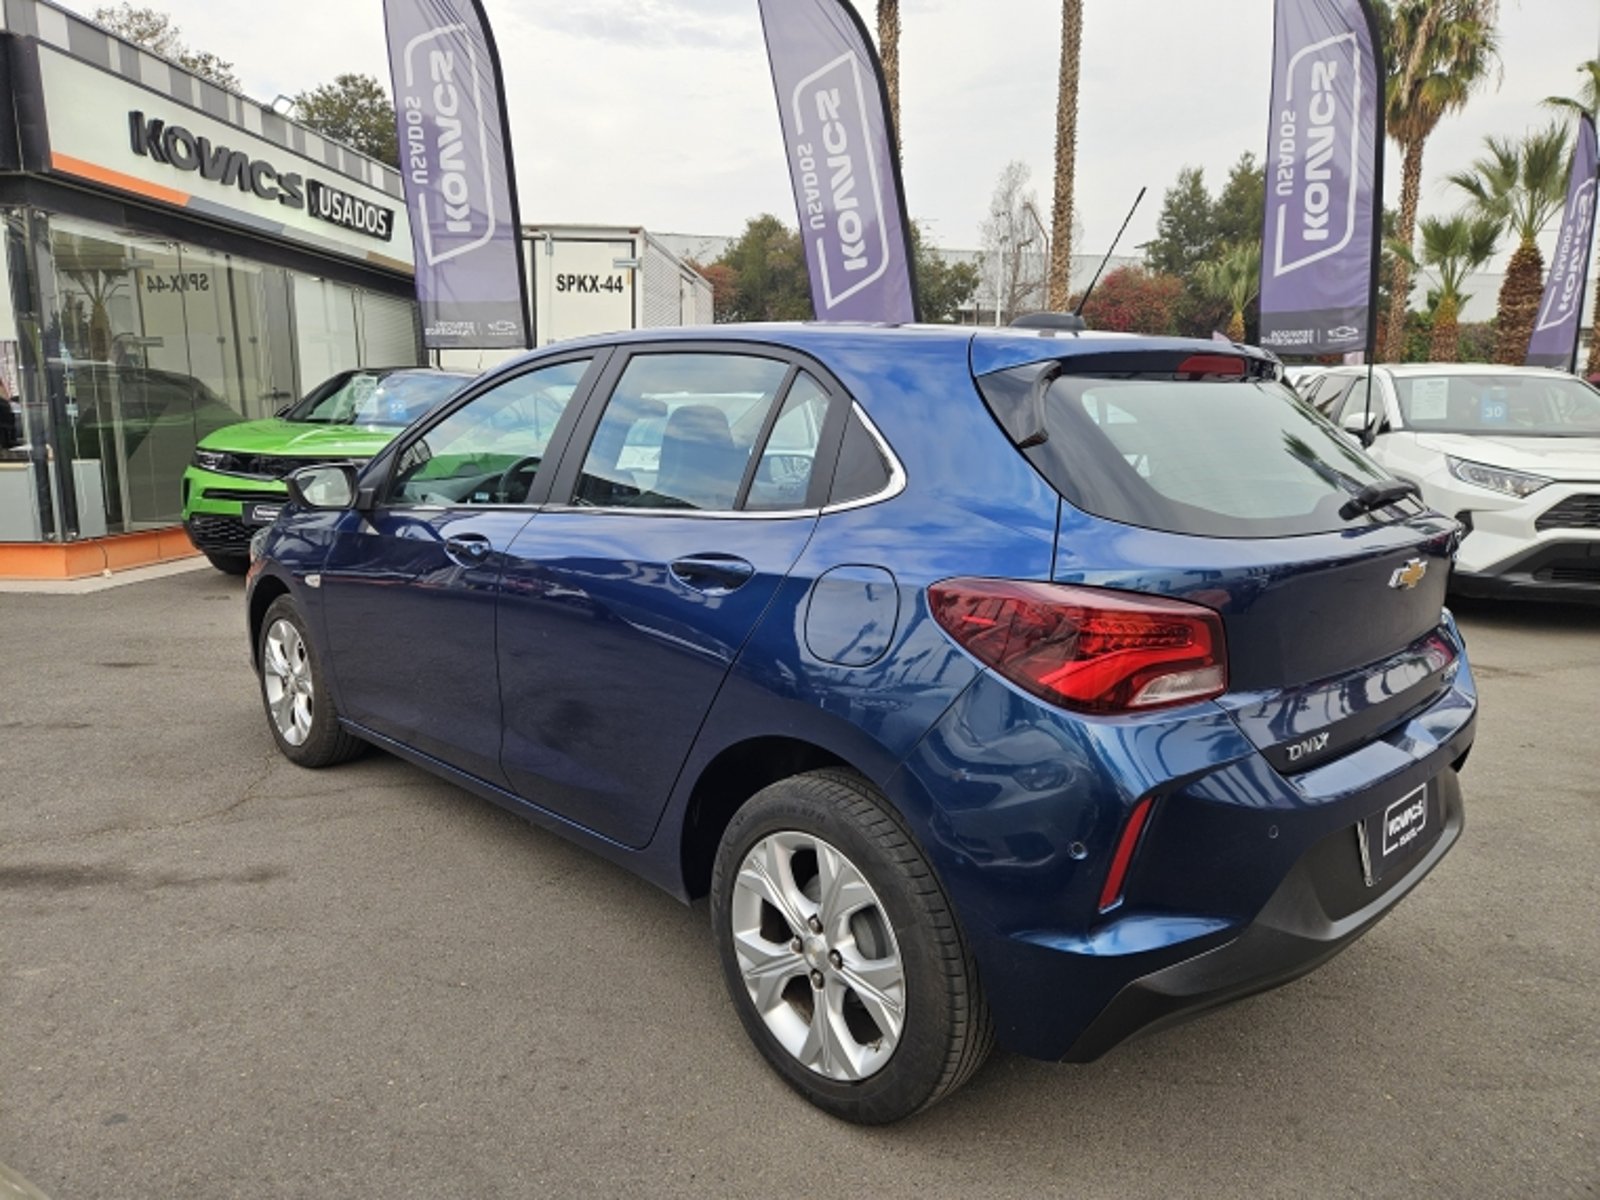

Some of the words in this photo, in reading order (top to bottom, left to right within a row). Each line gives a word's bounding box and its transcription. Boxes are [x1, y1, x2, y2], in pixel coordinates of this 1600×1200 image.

[128, 110, 305, 210] KOVACS
[318, 186, 388, 236] USADOS
[556, 273, 624, 293] SPKX-44
